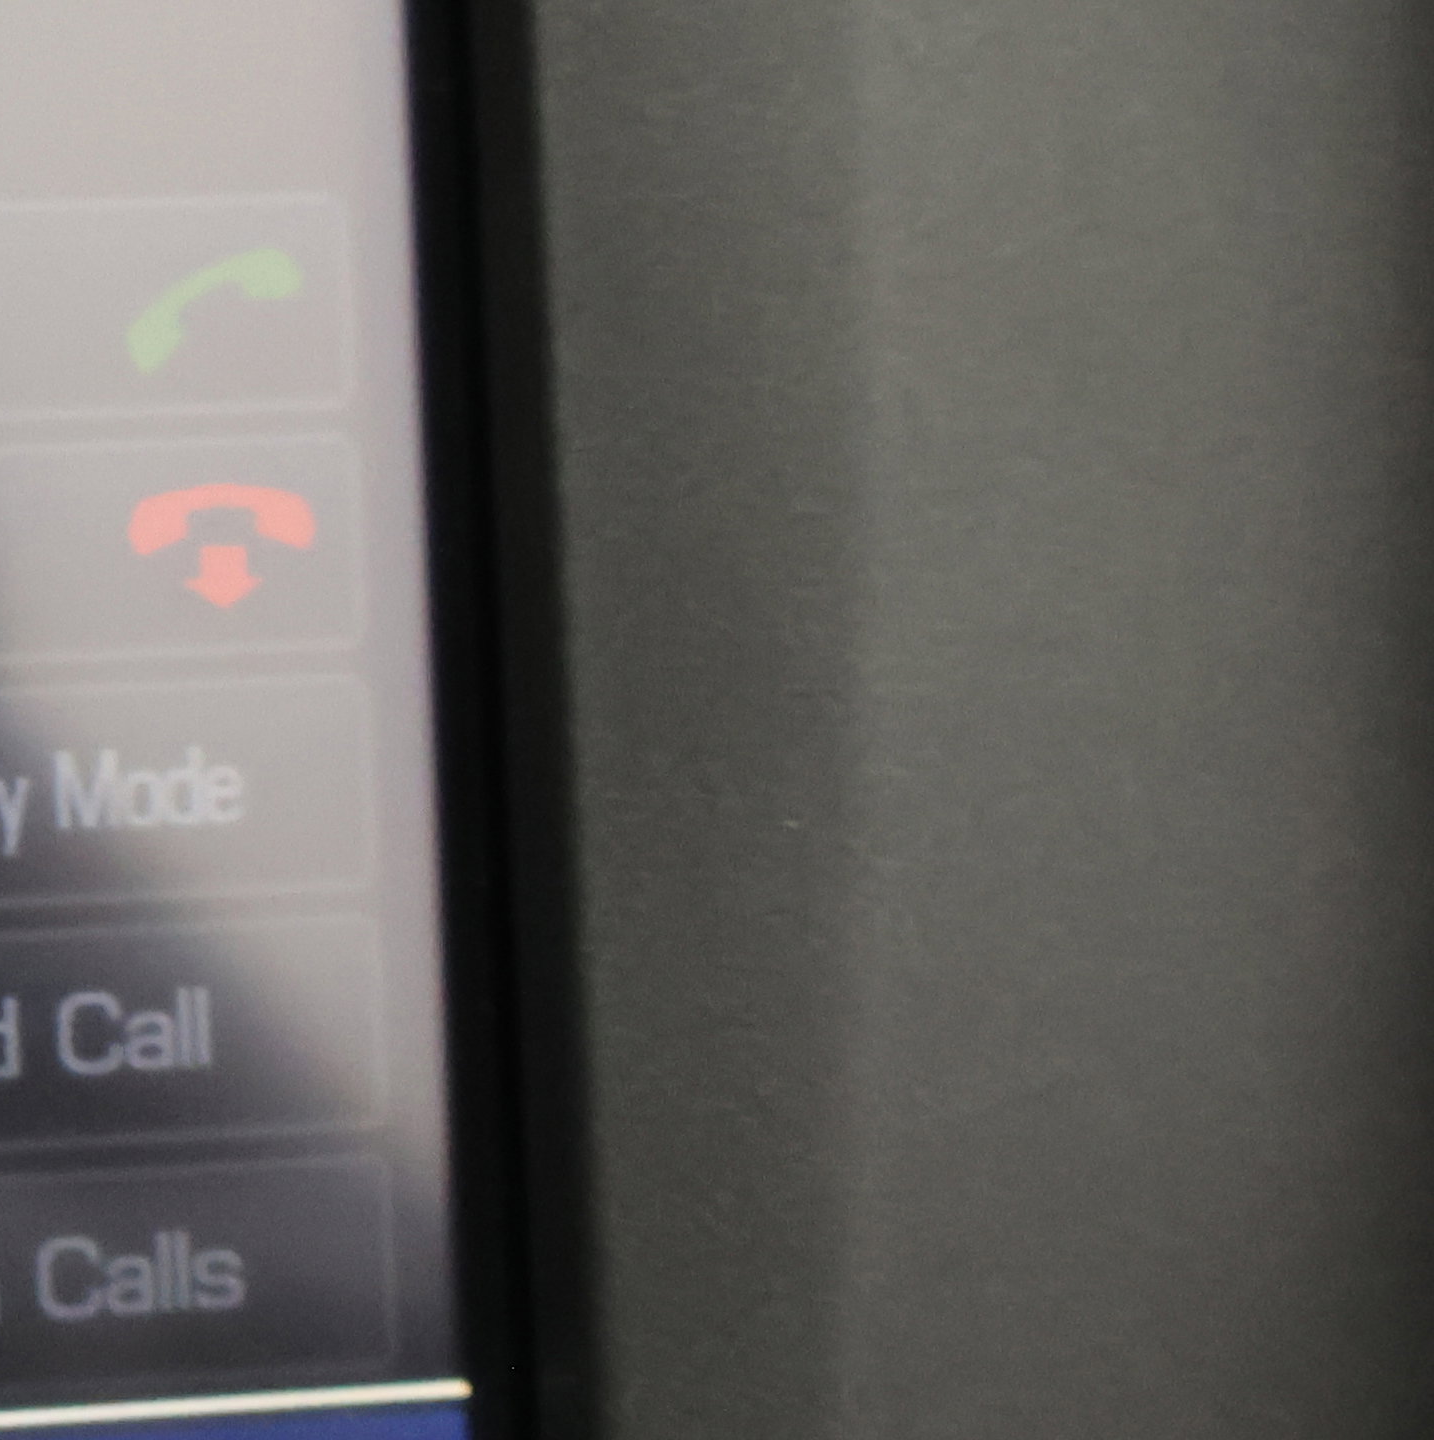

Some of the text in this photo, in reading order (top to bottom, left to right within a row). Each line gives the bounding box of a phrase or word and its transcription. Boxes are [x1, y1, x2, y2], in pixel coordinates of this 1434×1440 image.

[54, 747, 245, 832] Mode
[57, 988, 213, 1076] Call
[36, 1229, 245, 1322] Calls
